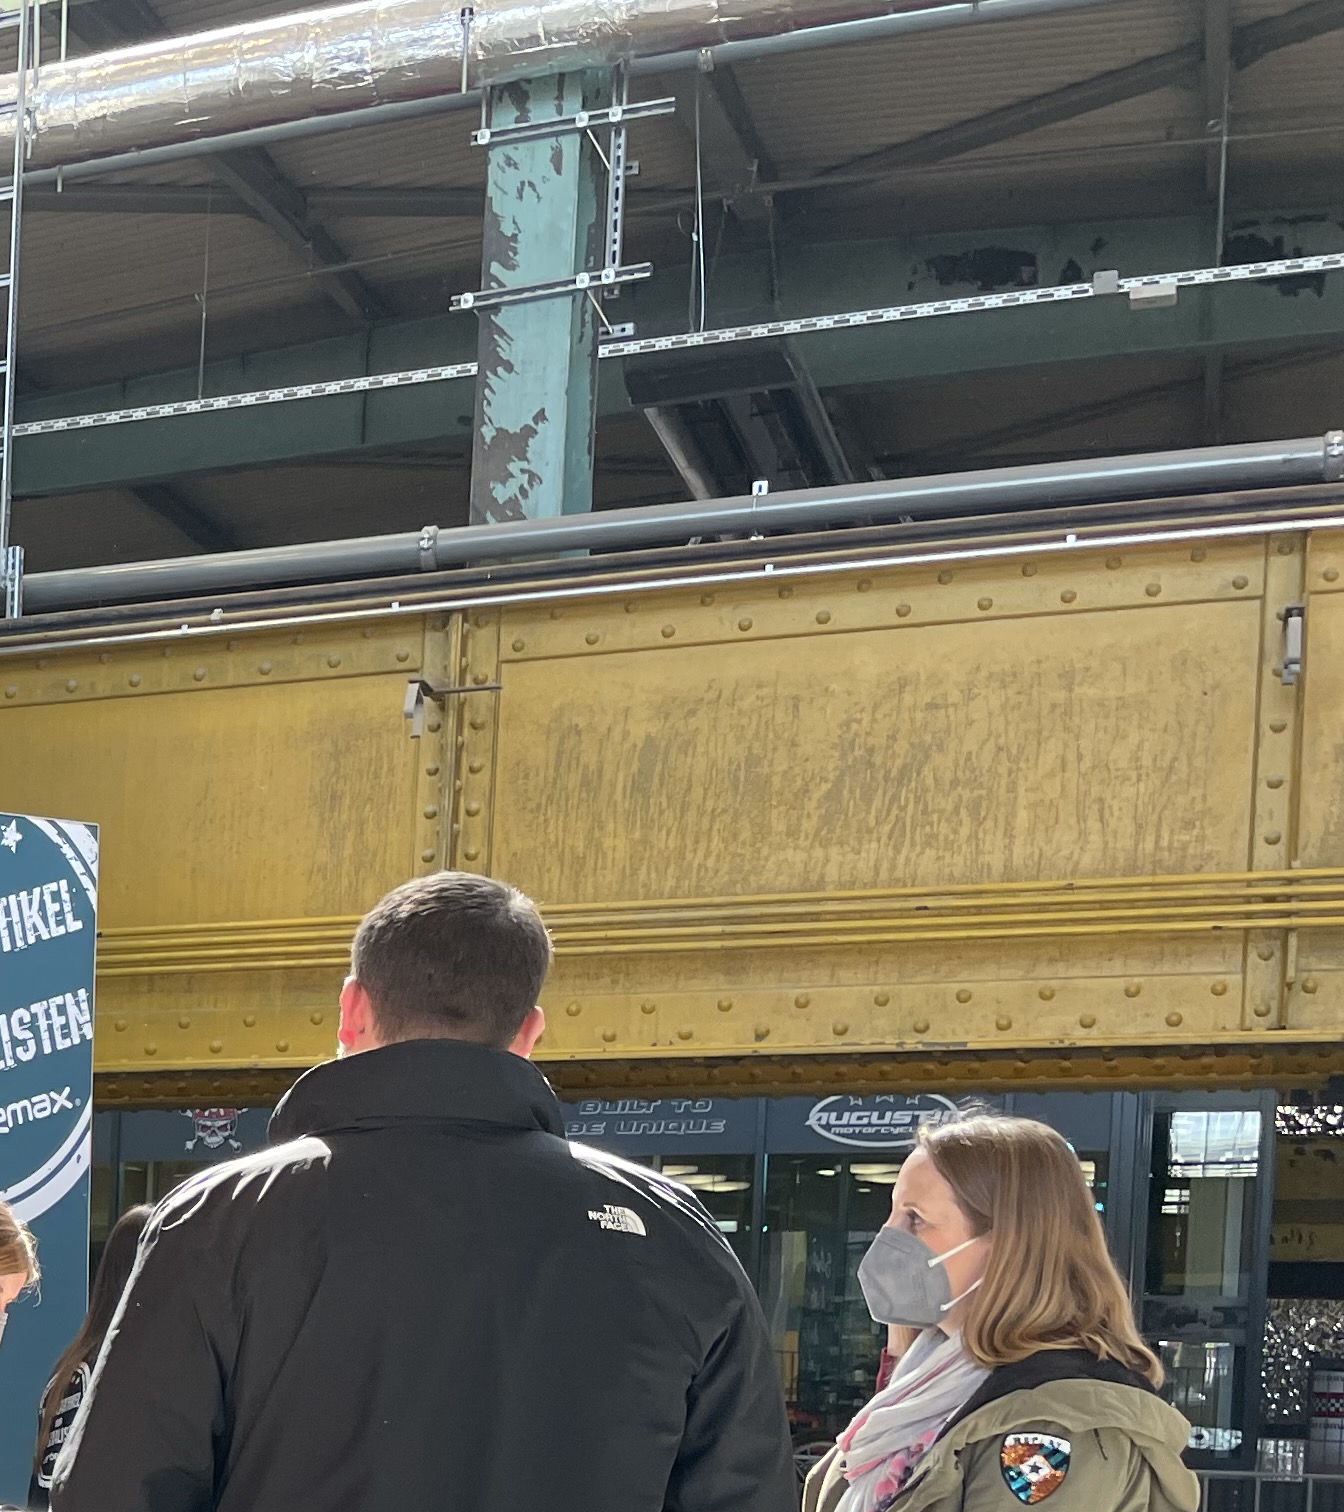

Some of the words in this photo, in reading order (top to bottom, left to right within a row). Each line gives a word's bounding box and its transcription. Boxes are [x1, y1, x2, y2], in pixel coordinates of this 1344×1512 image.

[579, 1099, 661, 1116] BUILT
[670, 1097, 714, 1113] TO
[565, 1120, 607, 1136] BE
[614, 1119, 727, 1136] UNIQUE
[602, 1204, 626, 1215] THE
[587, 1210, 627, 1224] NORTH
[599, 1220, 629, 1233] FACE
